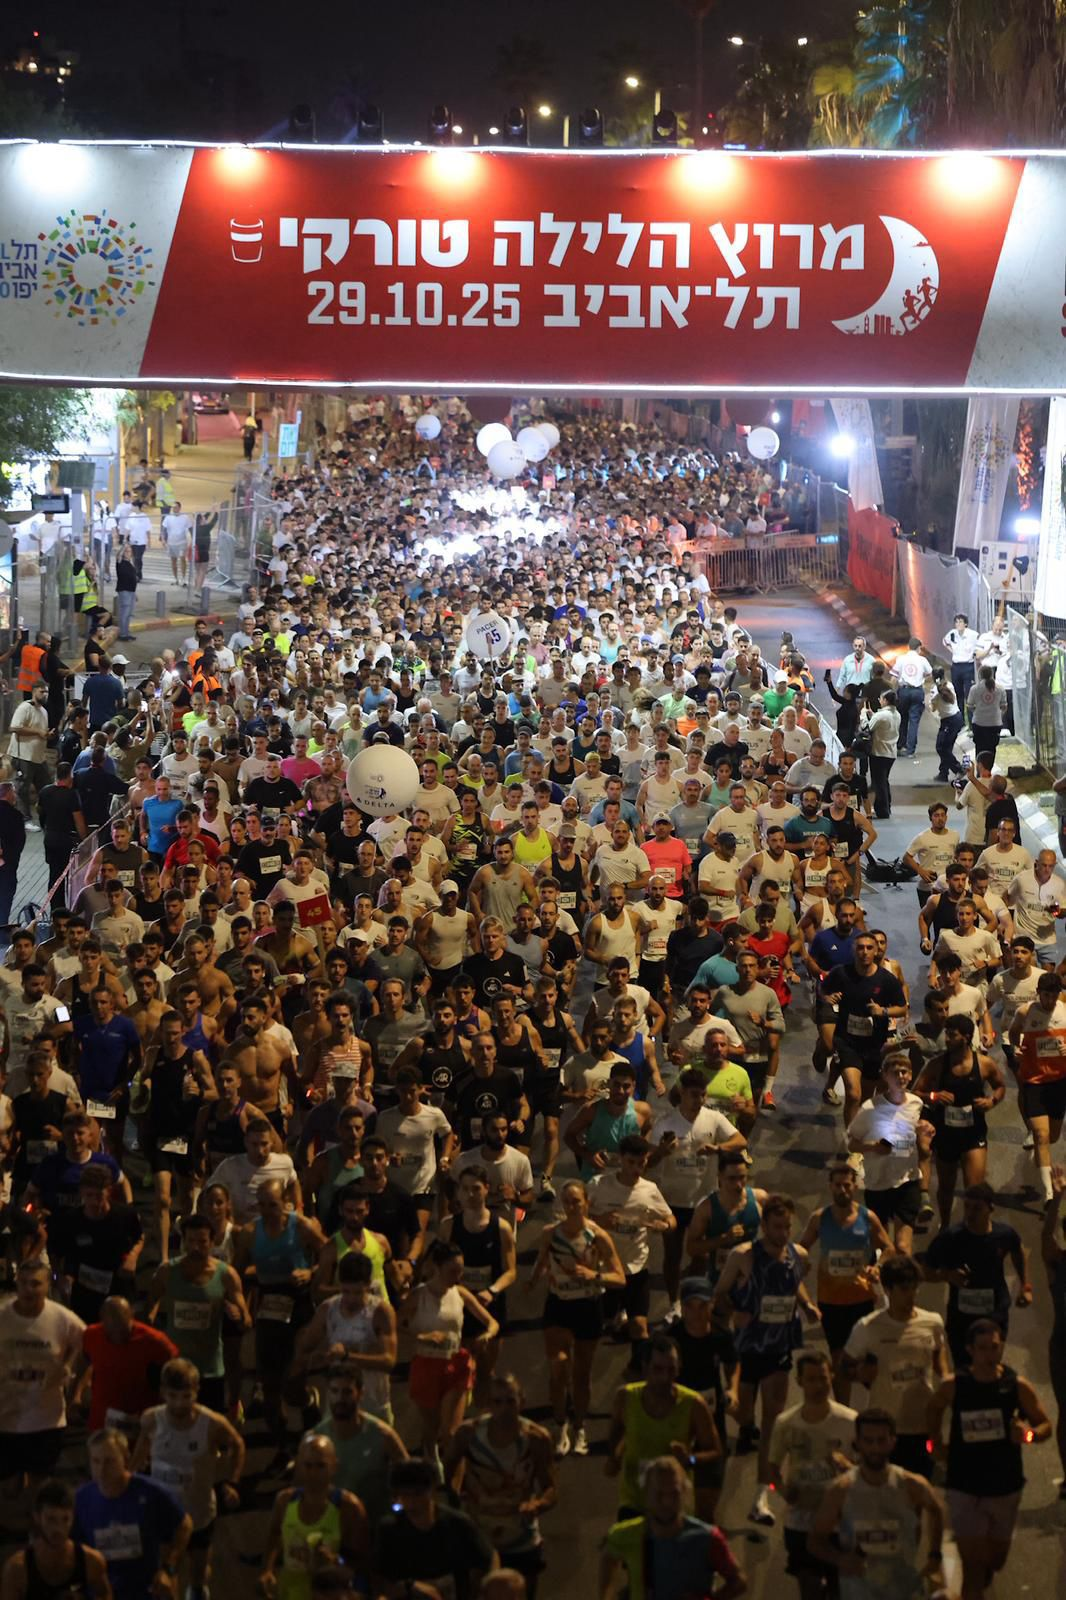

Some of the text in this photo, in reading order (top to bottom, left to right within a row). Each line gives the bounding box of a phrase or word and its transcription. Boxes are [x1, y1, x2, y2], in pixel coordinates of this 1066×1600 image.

[279, 212, 865, 279] מרוץ הלילה טורקי
[307, 281, 520, 327] 29.10.25
[476, 619, 499, 635] PACER
[364, 799, 395, 808] DELTA
